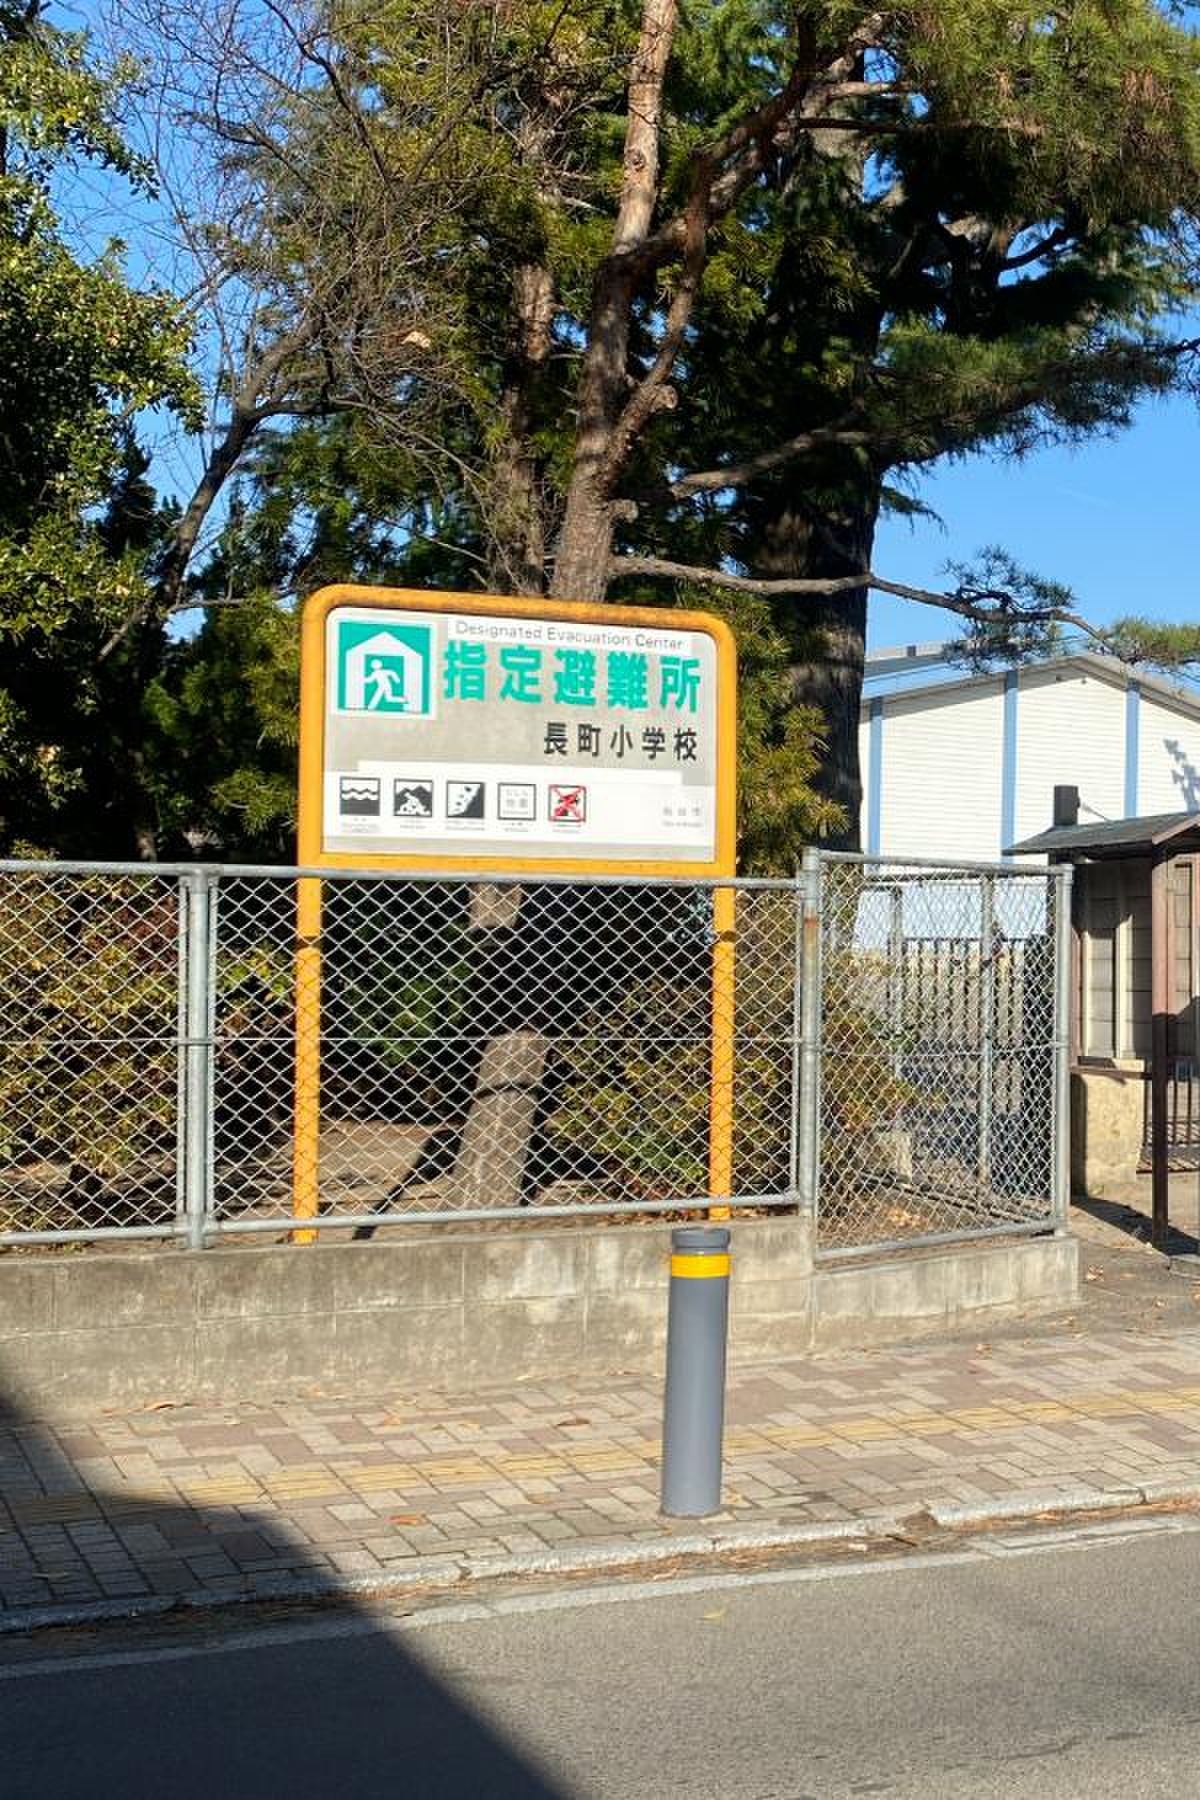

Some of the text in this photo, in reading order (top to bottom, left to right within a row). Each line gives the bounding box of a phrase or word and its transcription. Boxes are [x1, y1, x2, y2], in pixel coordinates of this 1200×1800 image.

[455, 620, 683, 649] Designated Evacuation Center
[443, 639, 701, 713] 指定避難所
[543, 721, 697, 761] 長町小学校
